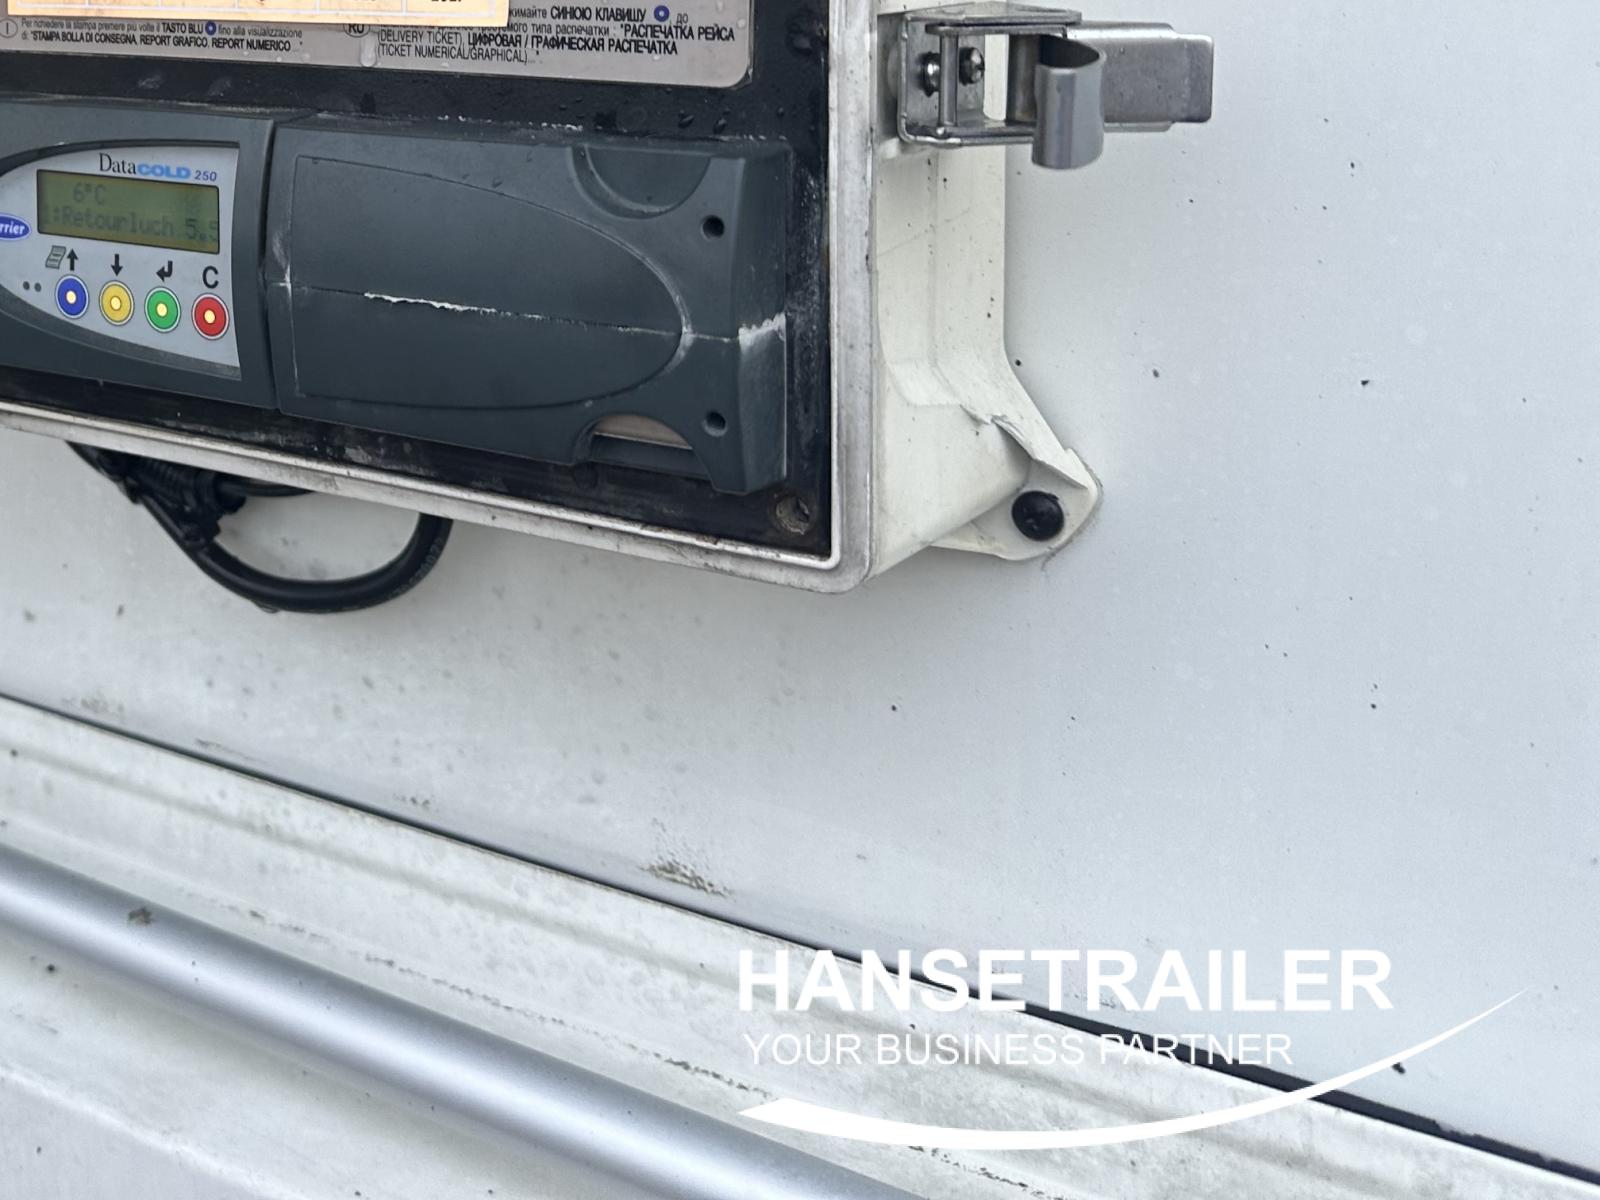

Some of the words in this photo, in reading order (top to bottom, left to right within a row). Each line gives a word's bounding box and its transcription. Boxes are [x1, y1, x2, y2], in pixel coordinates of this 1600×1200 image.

[162, 22, 187, 34] TASTO
[188, 23, 204, 34] BLU
[140, 35, 171, 46] REPORT
[212, 38, 245, 49] REPORT
[246, 40, 291, 51] NUMERICO
[194, 169, 218, 182] 250
[202, 266, 219, 289] C
